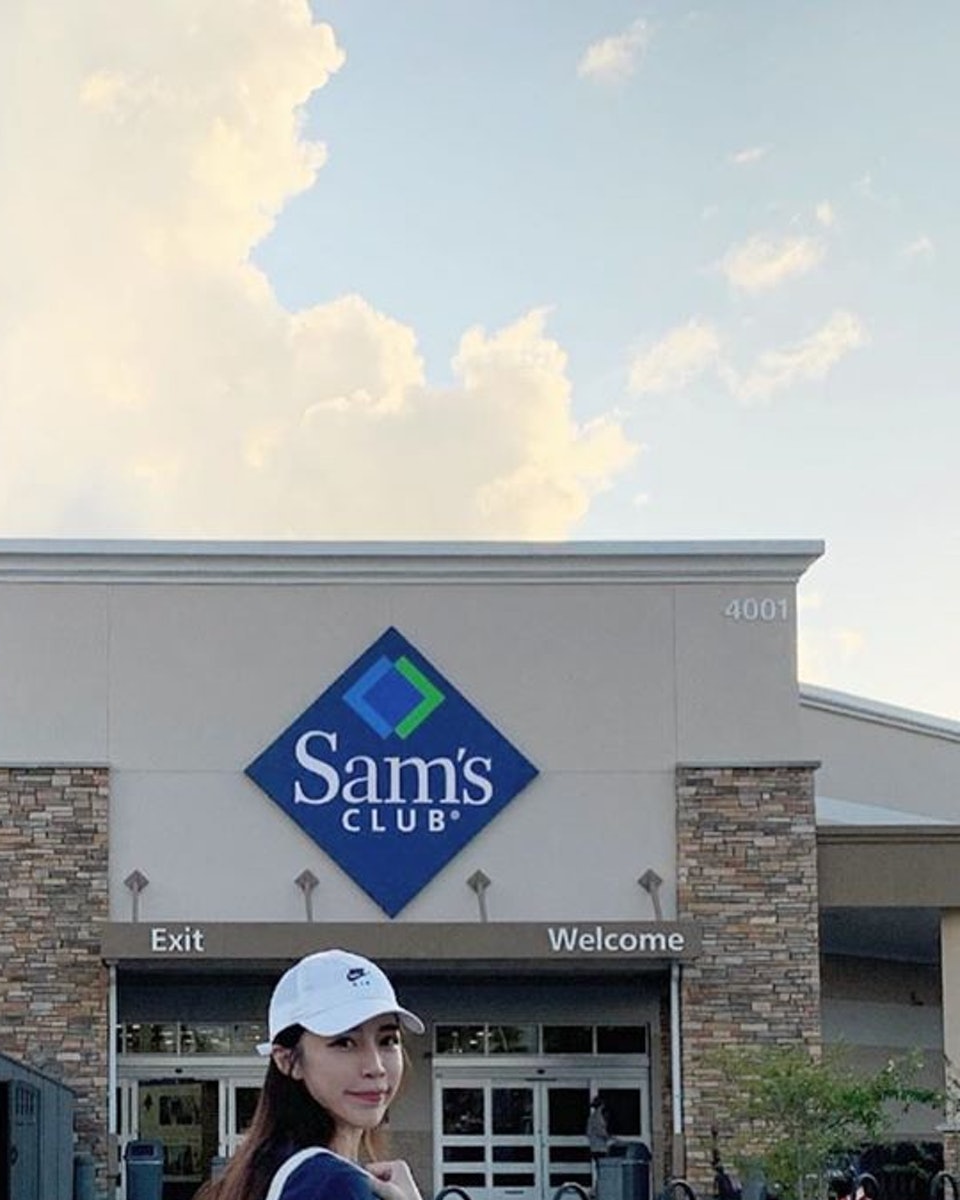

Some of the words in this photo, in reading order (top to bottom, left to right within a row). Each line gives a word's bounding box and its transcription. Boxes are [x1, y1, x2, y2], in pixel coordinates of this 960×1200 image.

[725, 598, 787, 620] 4001
[294, 730, 493, 805] Sam's
[151, 926, 204, 952] Exit
[548, 926, 685, 951] Welcome
